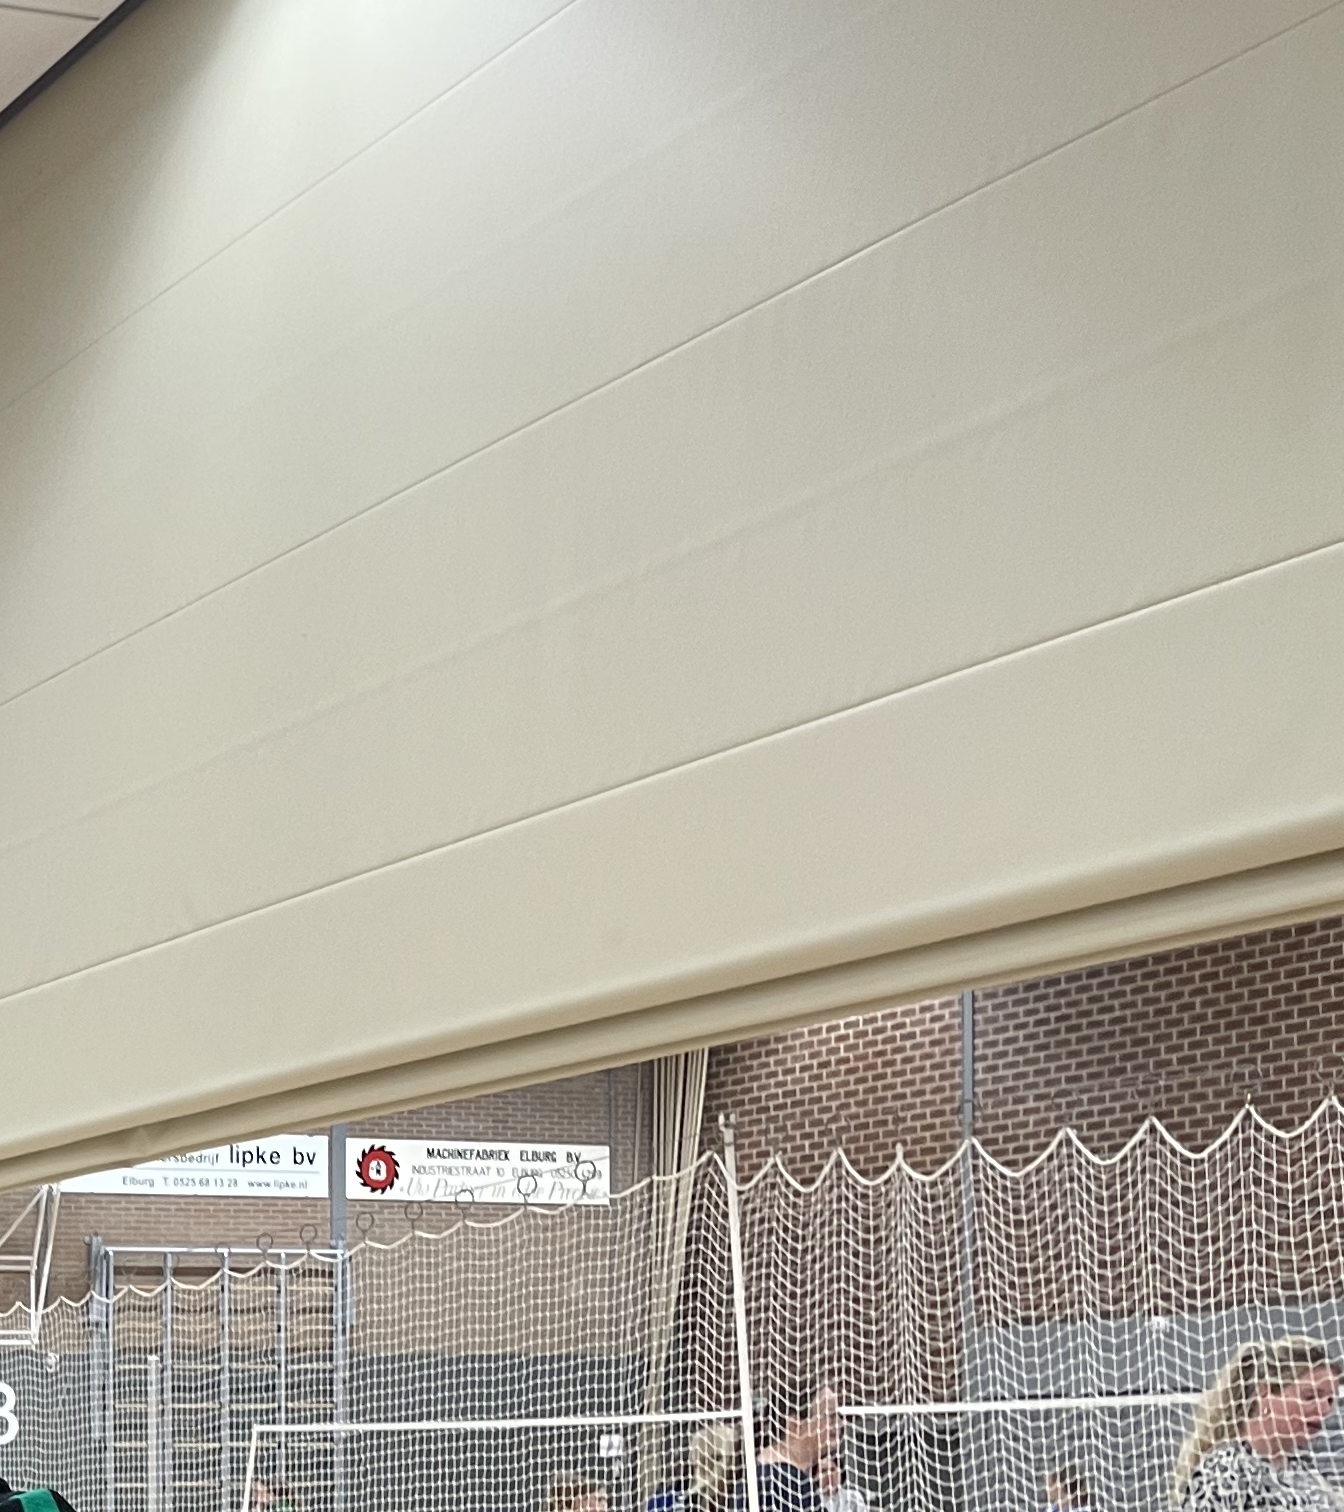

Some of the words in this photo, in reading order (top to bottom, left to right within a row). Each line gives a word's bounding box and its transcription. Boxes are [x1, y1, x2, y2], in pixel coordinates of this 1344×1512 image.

[229, 1144, 281, 1168] lipke
[293, 1147, 317, 1166] bv
[426, 1147, 511, 1161] MACHINEFABRIEK
[519, 1149, 557, 1163] ELBURG
[122, 1176, 155, 1187] Elburg
